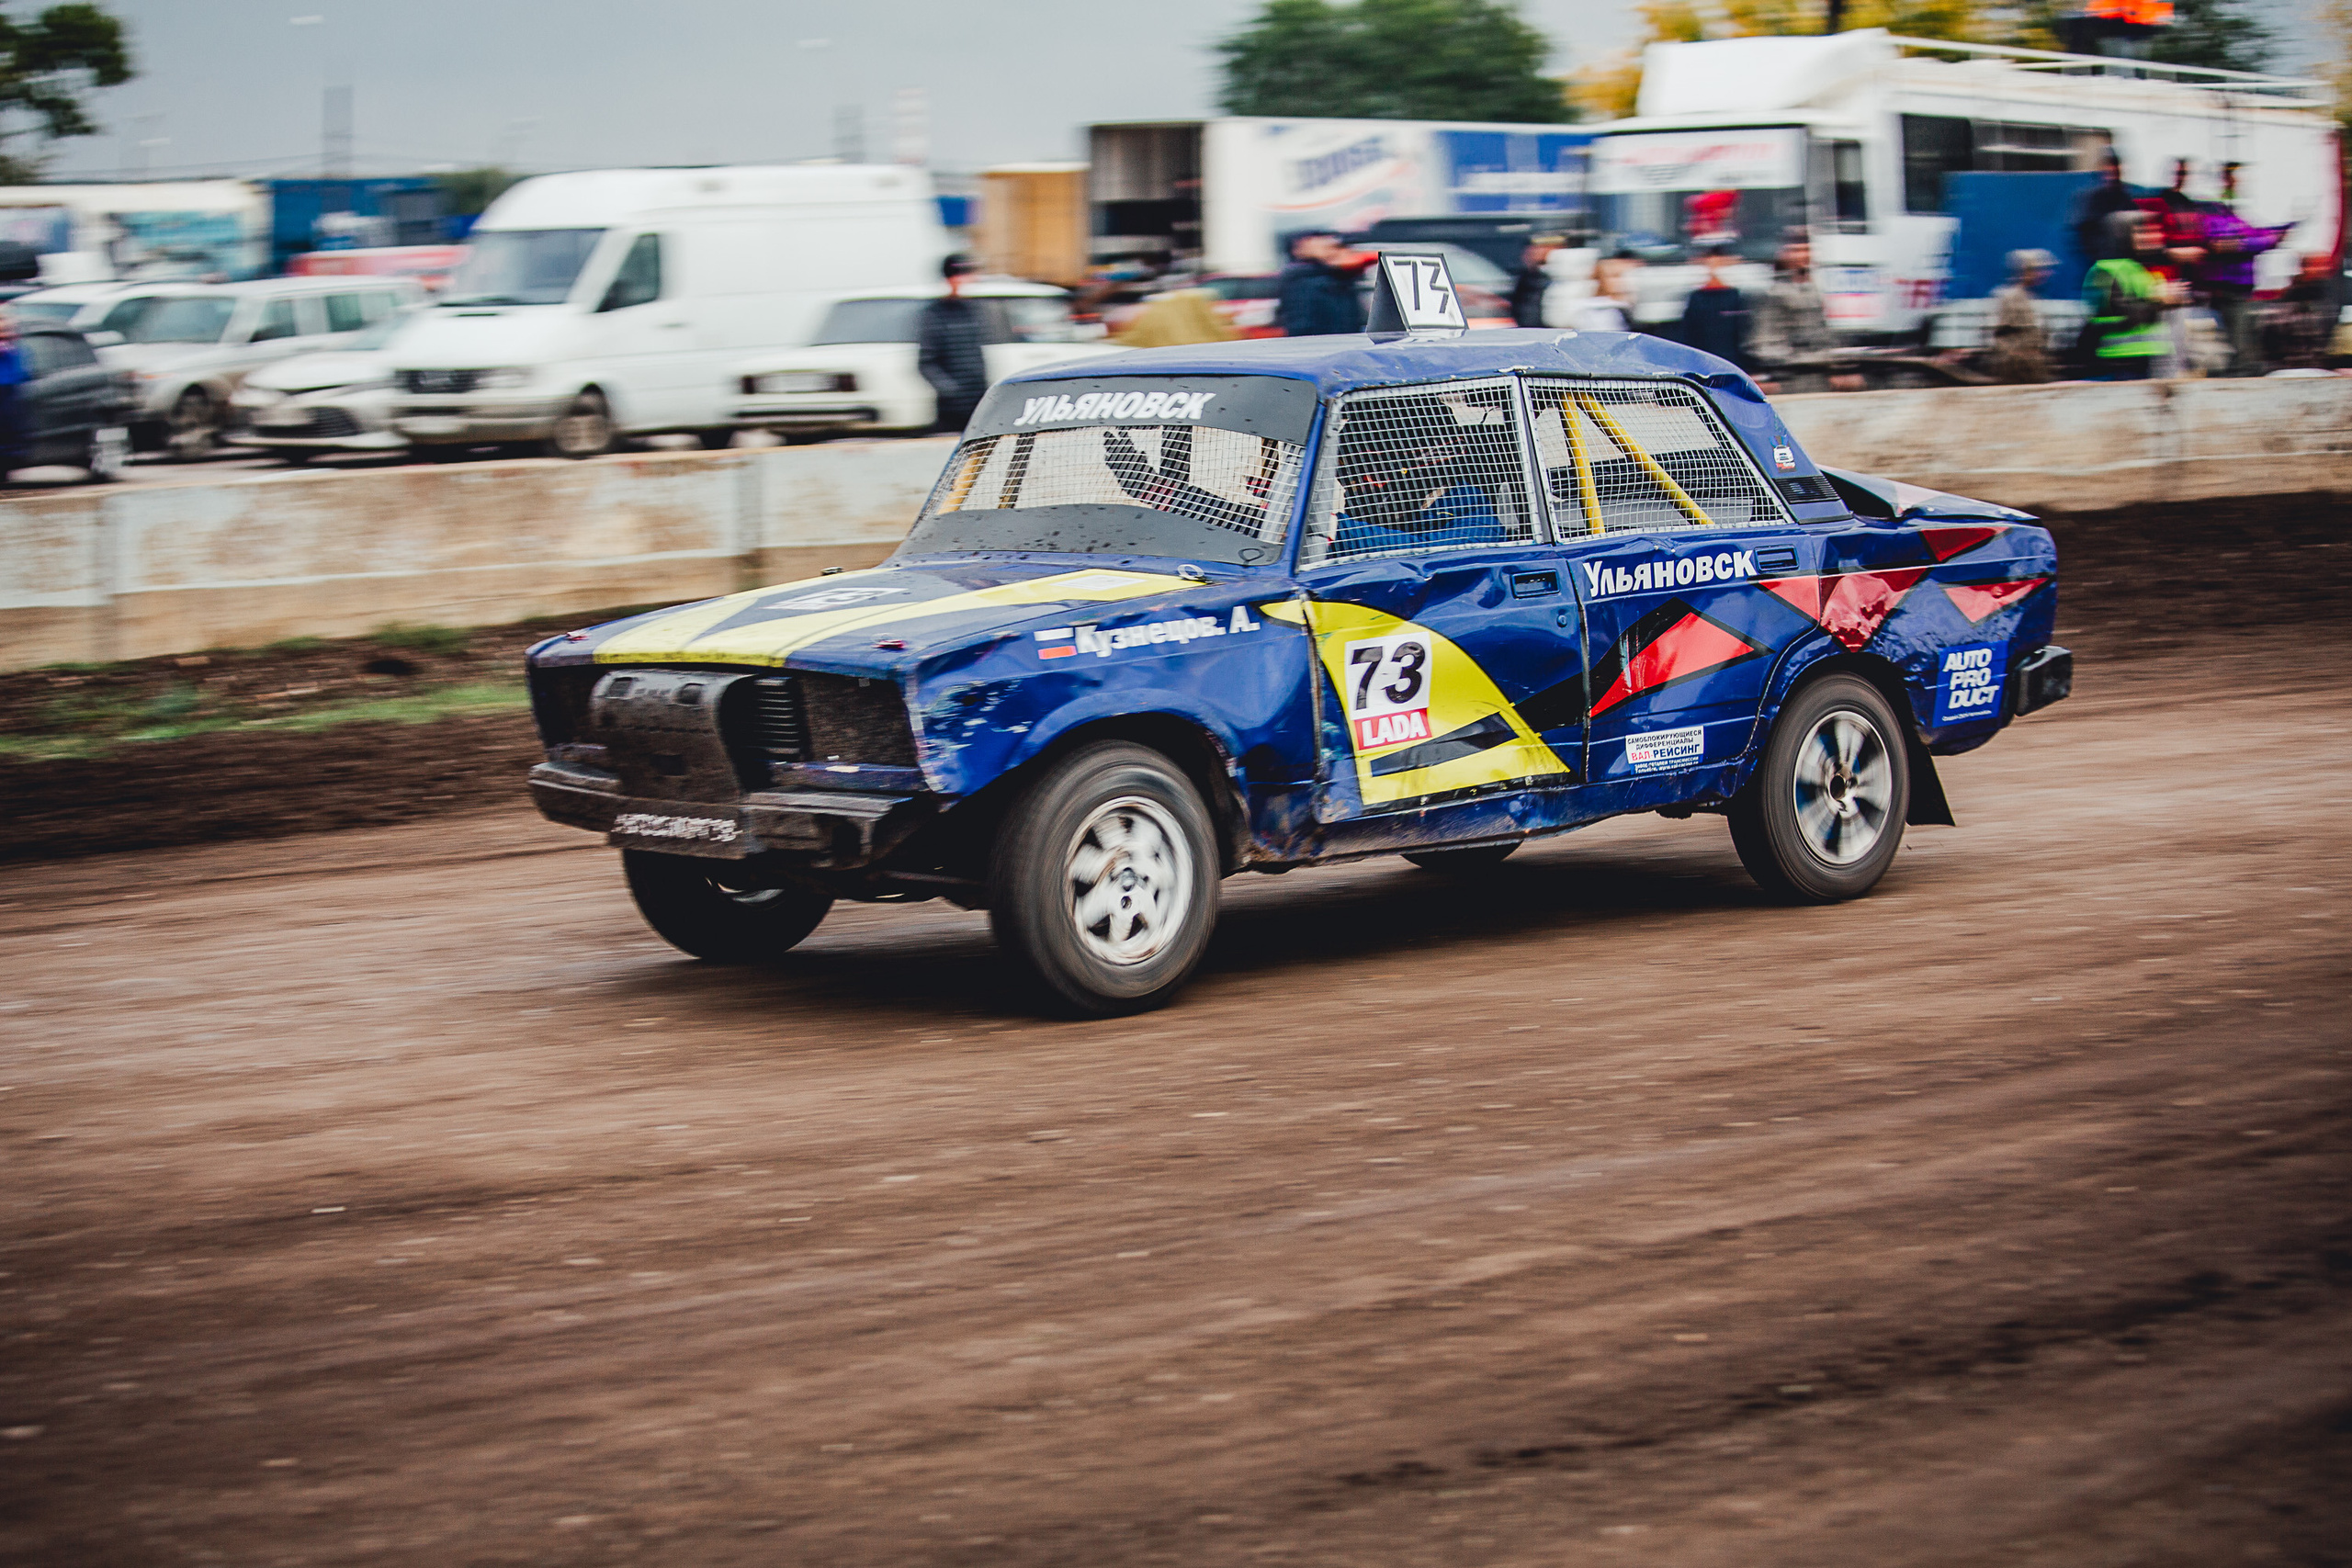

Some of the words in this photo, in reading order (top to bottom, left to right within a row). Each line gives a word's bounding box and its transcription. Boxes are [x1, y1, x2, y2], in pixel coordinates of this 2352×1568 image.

[1393, 260, 1449, 313] 73
[1012, 391, 1216, 426] УЛЬЯНОВСК
[1942, 648, 1993, 672] AUTO
[1351, 641, 1426, 710] 73
[1949, 667, 1992, 691] PRO
[1948, 685, 2001, 709] DUCT
[1362, 711, 1428, 747] LADA
[1627, 729, 1702, 744] САМОБЛОКИРУЮЩИЕСЯ
[1636, 738, 1693, 750] ДИФФЕРЕНЦИАЛЫ
